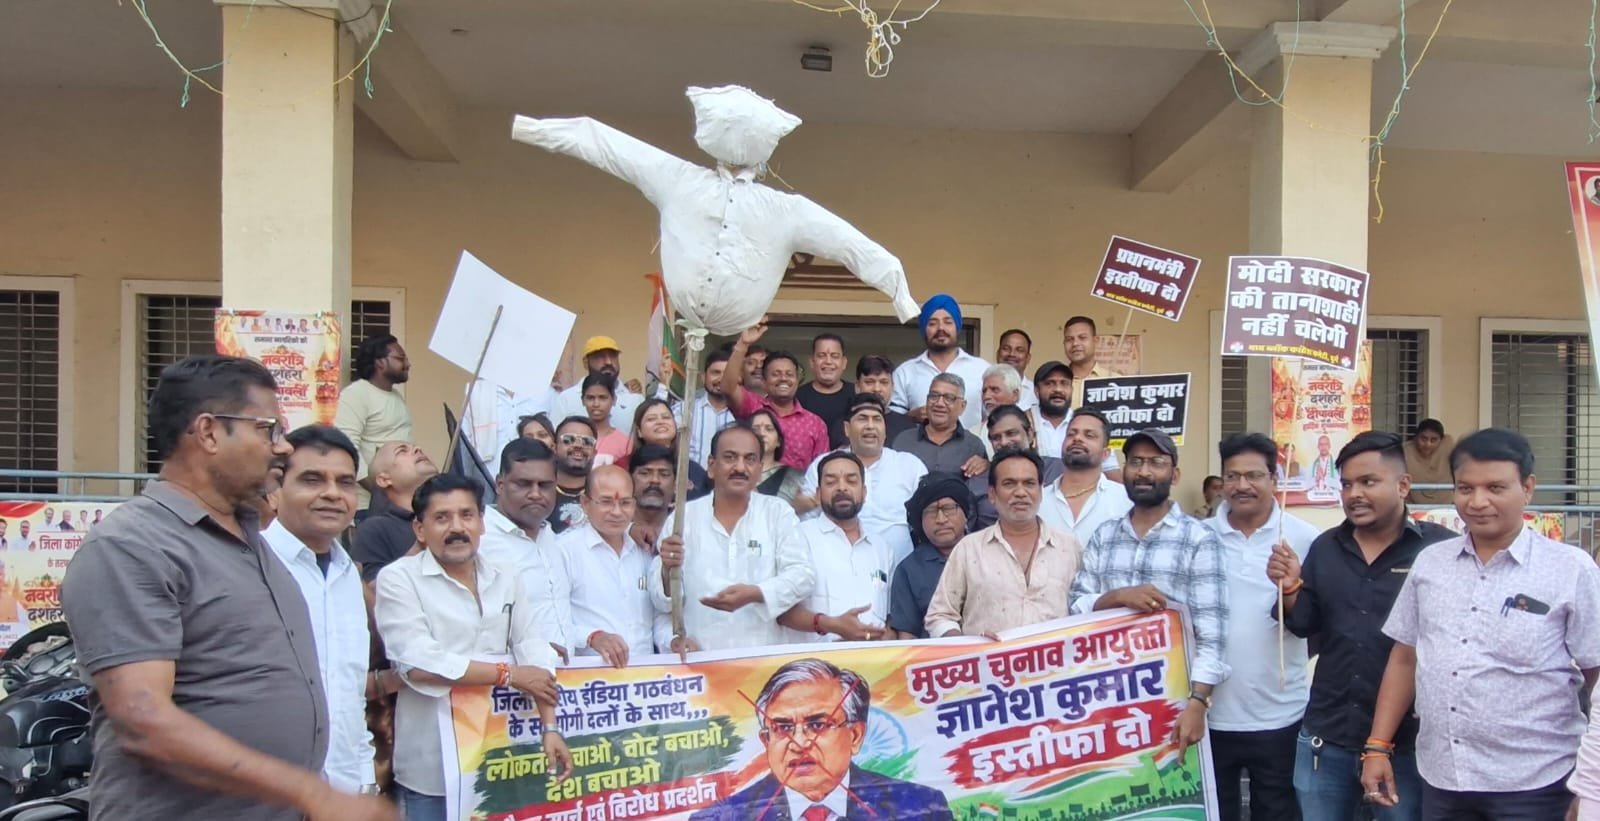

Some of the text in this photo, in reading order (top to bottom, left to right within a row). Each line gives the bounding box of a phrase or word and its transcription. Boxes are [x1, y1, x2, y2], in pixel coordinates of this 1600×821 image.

[1116, 247, 1186, 279] प्रधानमंत्री
[1237, 260, 1362, 297] मोदी सरकार
[1104, 268, 1181, 302] इस्तीफा दो
[1231, 286, 1360, 325] की तानाशाही
[1241, 313, 1348, 349] नहीं चलेगी
[1087, 382, 1186, 405] ज्ञानेश कुमार
[1101, 403, 1176, 424] स्तीफा दो
[40, 535, 62, 550] जिला
[28, 607, 64, 624] दशहर
[911, 619, 1166, 704] मुख्य चुनाव आयुक्त
[491, 686, 533, 712] जिला
[580, 680, 628, 707] इंडिया
[633, 674, 703, 699] गठबंधन
[936, 659, 1164, 739] ज्ञानेश कुमार
[508, 714, 525, 738] के
[587, 700, 620, 729] दलों
[624, 702, 643, 722] के
[485, 721, 729, 782] लोकतं चाओ, वोट बचाओ,
[969, 706, 1152, 783] इस्तीफा दो
[545, 757, 661, 803] देश बचाओ
[609, 790, 660, 820] विरोध
[662, 778, 717, 810] प्रदर्शन
